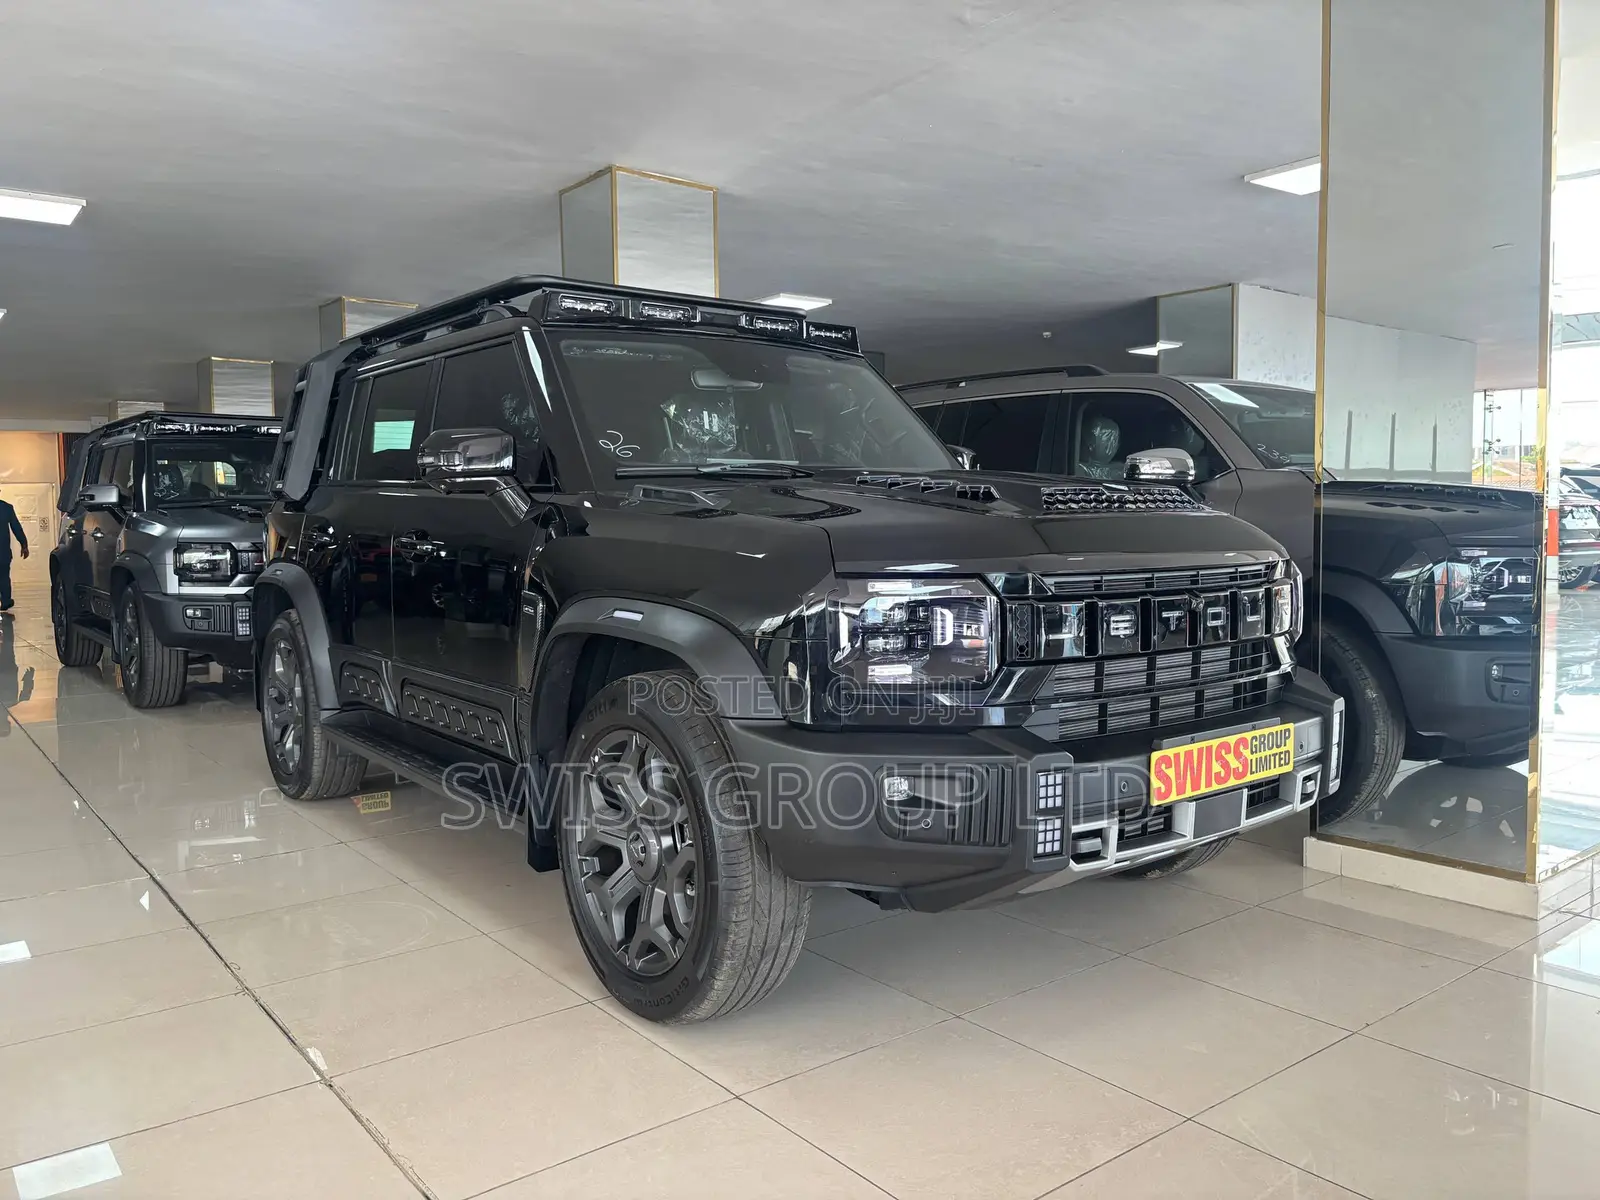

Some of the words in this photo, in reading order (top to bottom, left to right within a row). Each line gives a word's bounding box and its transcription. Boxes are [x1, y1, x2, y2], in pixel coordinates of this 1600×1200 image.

[598, 430, 641, 458] 26
[1250, 727, 1291, 755] GROUP
[1153, 736, 1250, 802] SWISS
[1250, 749, 1291, 775] LIMITED
